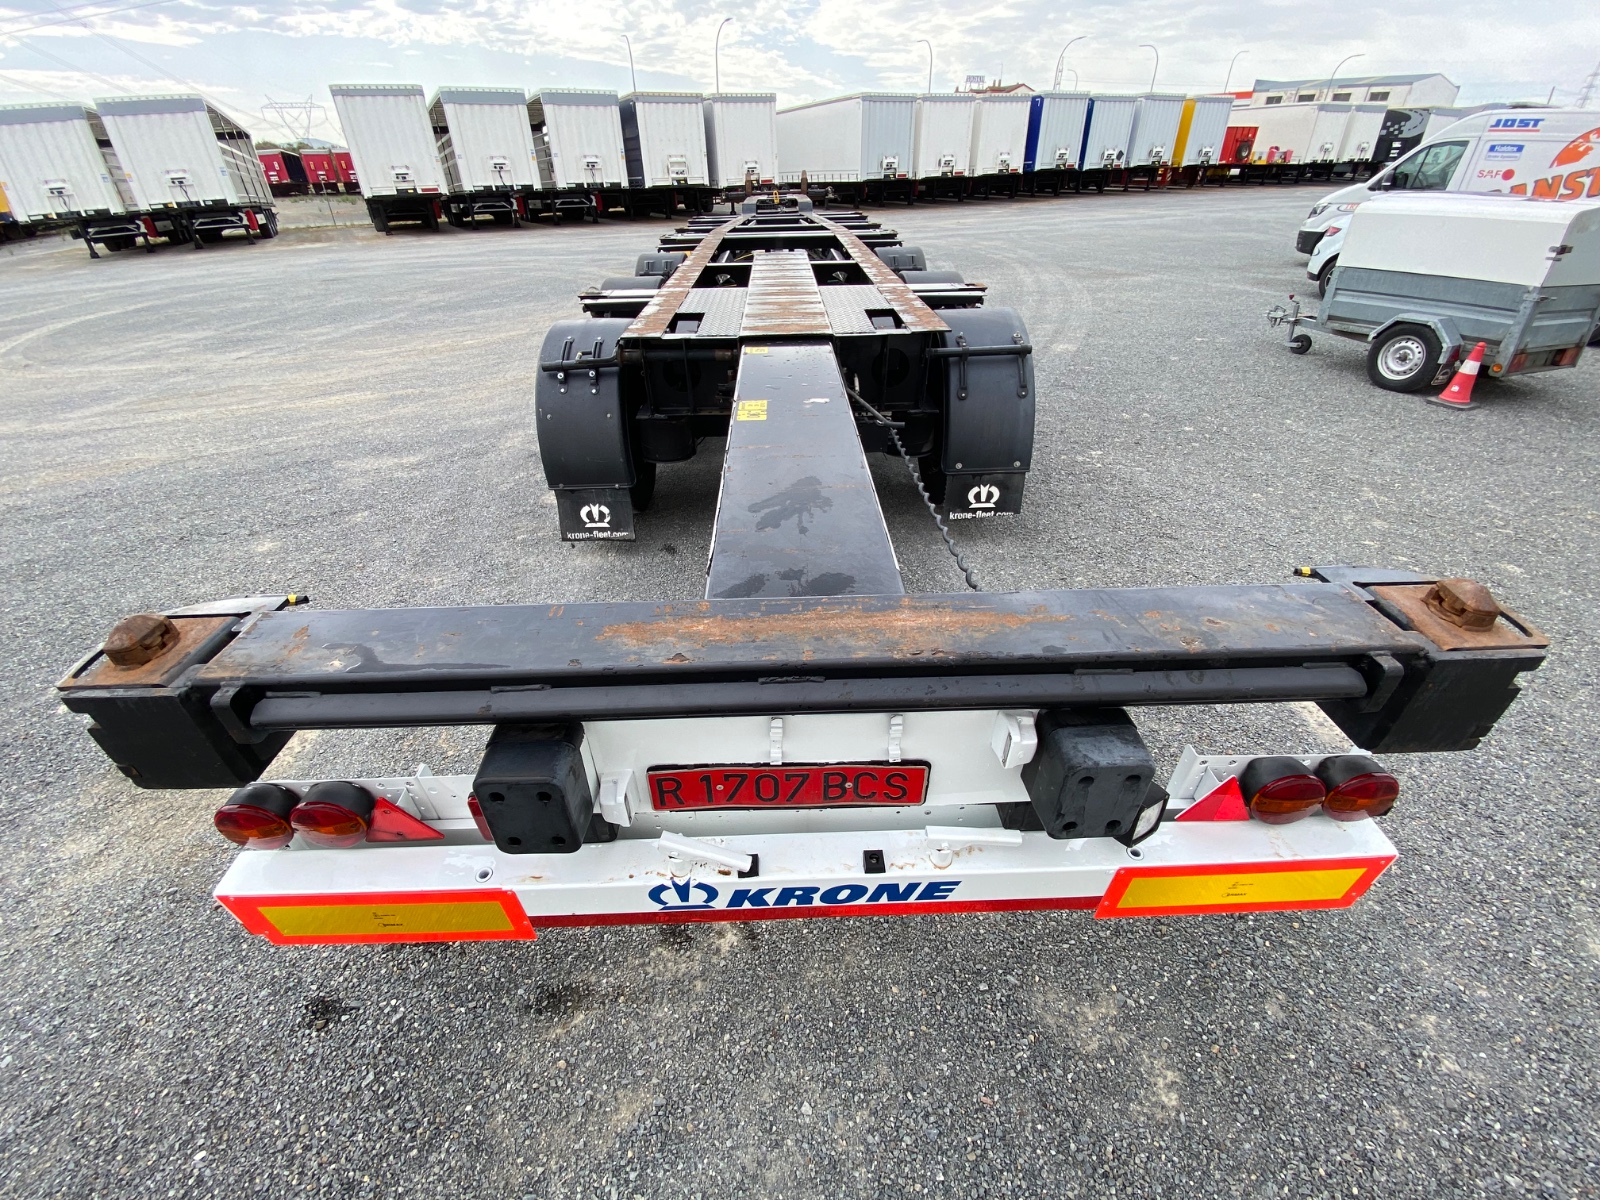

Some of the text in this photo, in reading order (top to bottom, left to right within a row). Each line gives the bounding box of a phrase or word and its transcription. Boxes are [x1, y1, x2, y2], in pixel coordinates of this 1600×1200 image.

[1489, 118, 1546, 128] JOST
[1477, 169, 1502, 179] SAF
[655, 771, 909, 807] R 1707 BCS
[726, 880, 963, 908] KRONE
